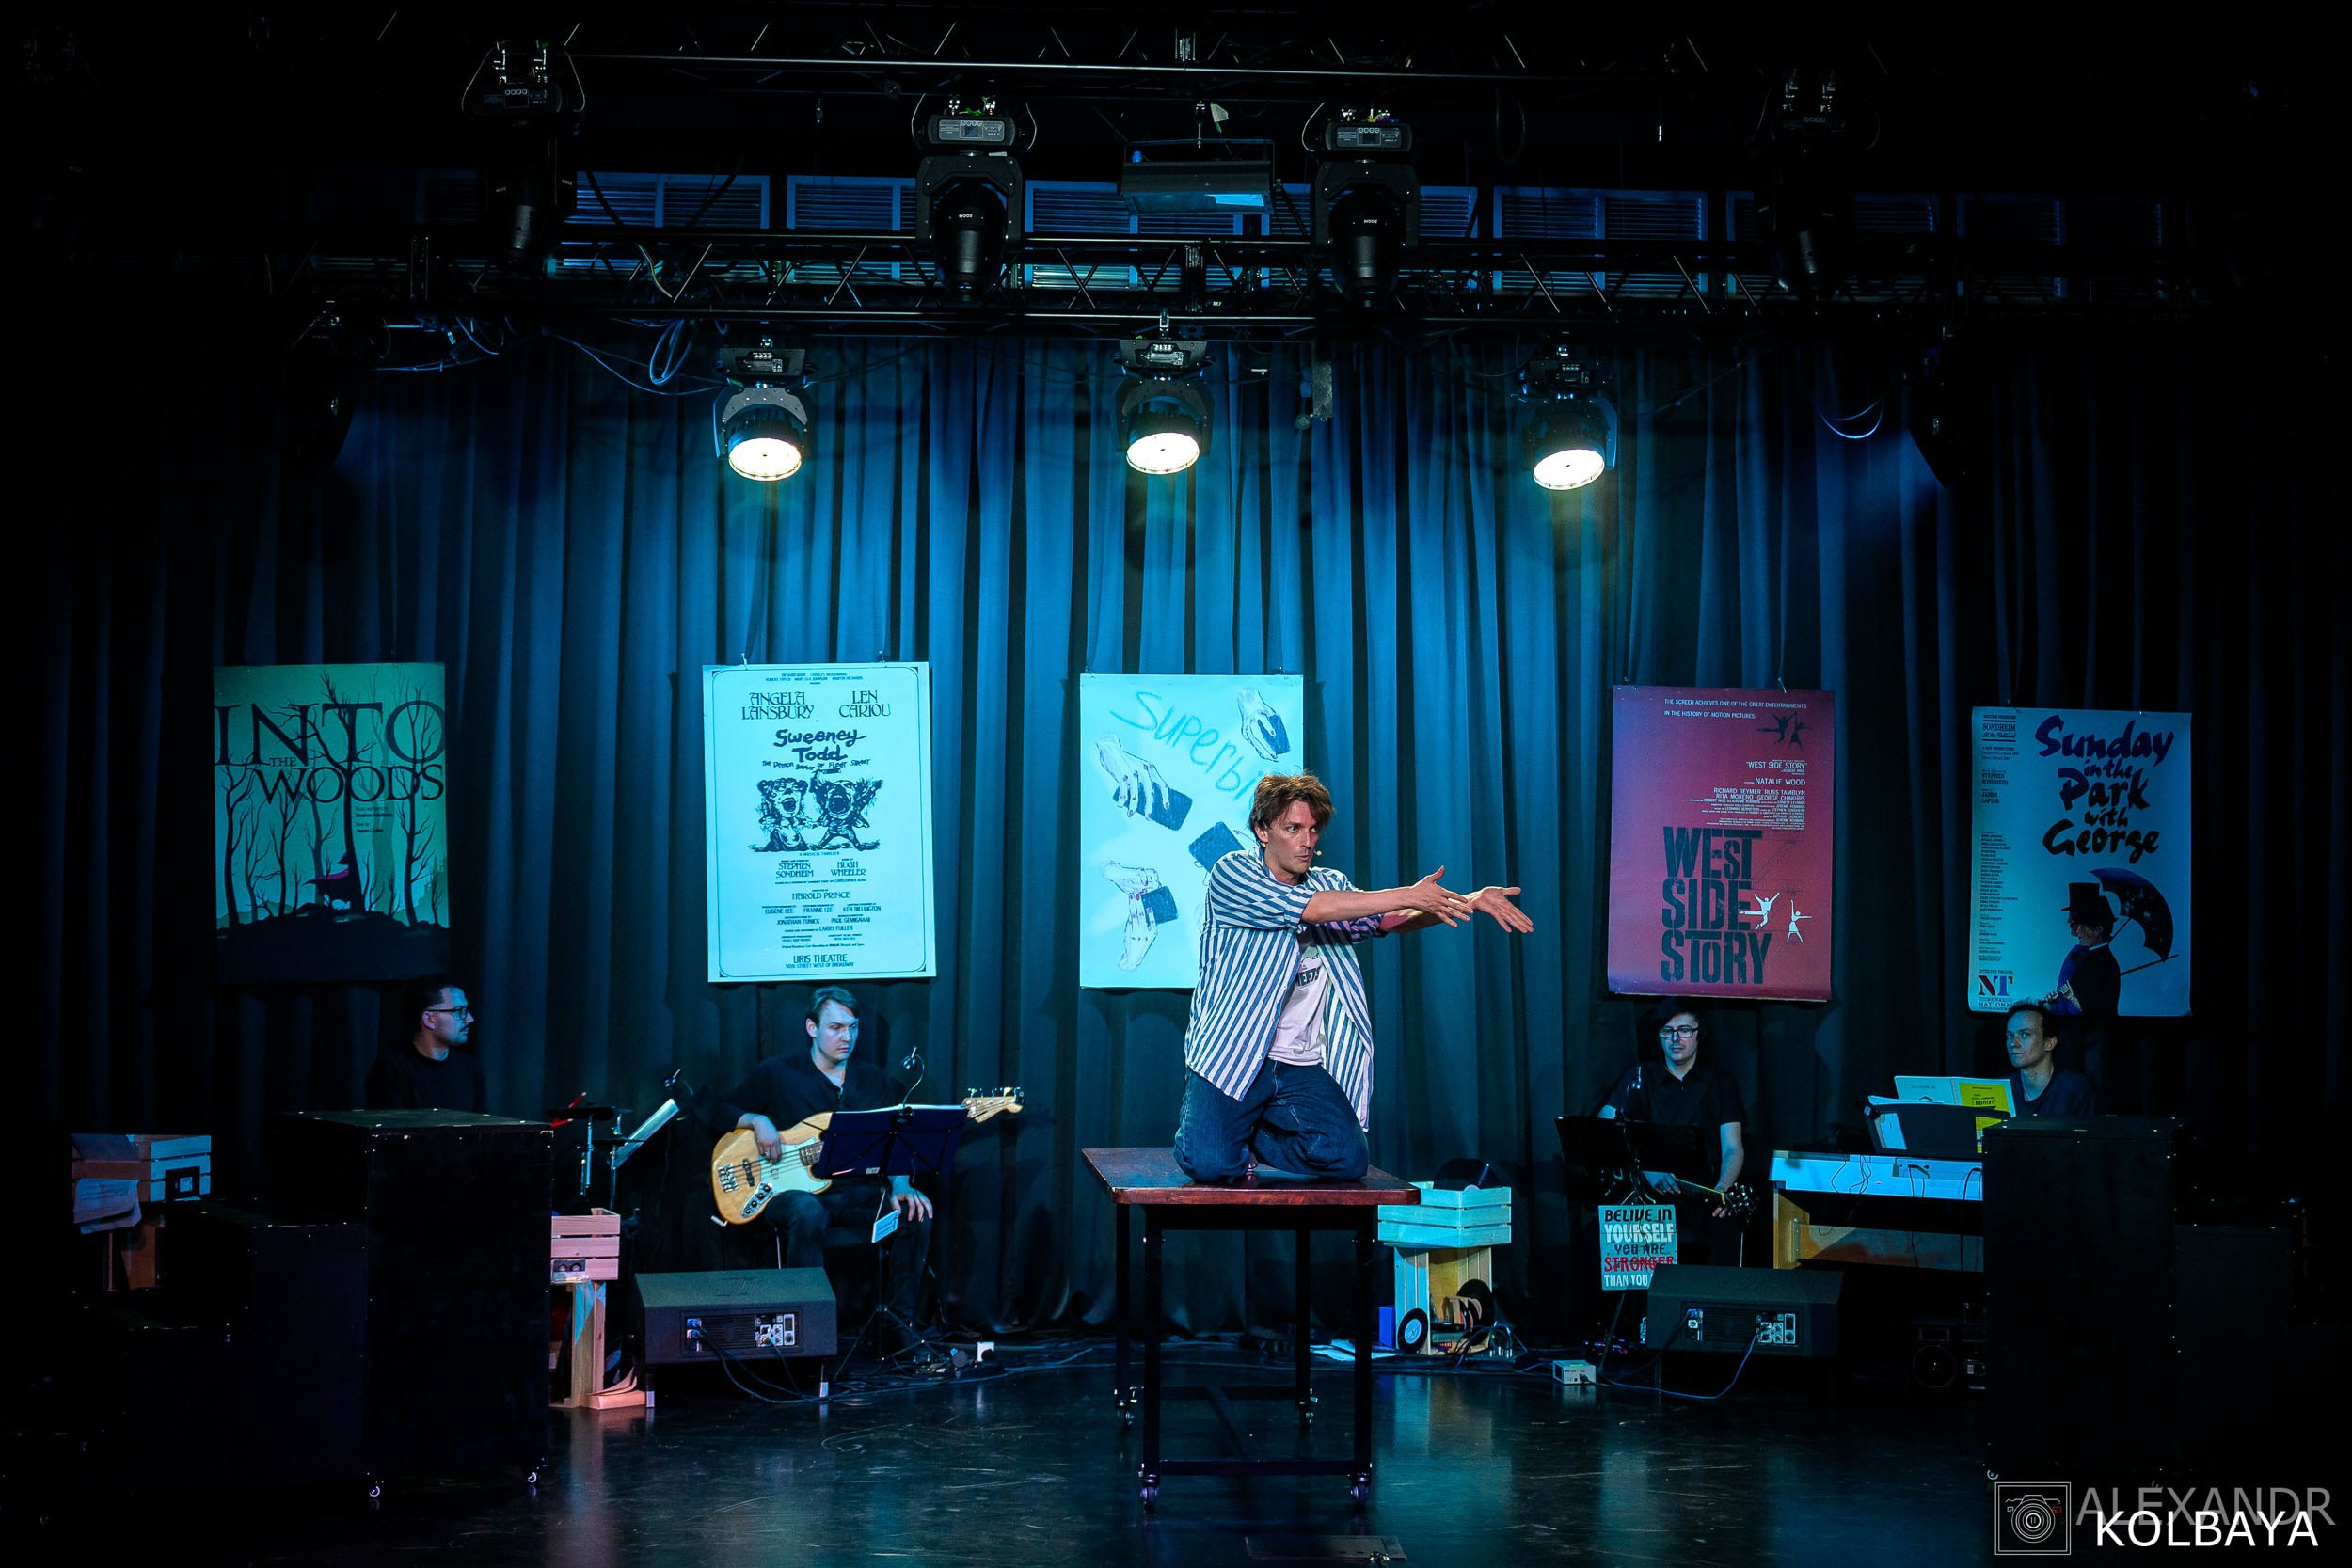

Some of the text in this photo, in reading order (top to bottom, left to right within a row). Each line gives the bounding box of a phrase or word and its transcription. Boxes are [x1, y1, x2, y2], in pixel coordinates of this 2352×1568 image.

[749, 691, 805, 705] ANGELA
[851, 690, 878, 704] LEN
[741, 705, 815, 720] LANSBURY
[839, 704, 891, 718] CARIOU
[214, 700, 445, 766] INTO
[773, 728, 867, 747] Sweeney
[2035, 714, 2174, 767] Sunday
[792, 745, 848, 763] Todd
[1109, 691, 1263, 810] Superbi
[269, 757, 297, 767] THE
[1769, 761, 1783, 769] SIDE
[2084, 758, 2133, 778] in the
[246, 765, 444, 804] WOODS
[2058, 767, 2150, 811] Park
[2085, 806, 2128, 827] with
[2042, 818, 2160, 864] George
[1663, 826, 1762, 879] WEST
[1661, 878, 1752, 930] SIDE
[794, 954, 848, 963] URIS THEATRE
[1661, 929, 1772, 984] STORY
[1978, 975, 2013, 996] NT
[1605, 1209, 1653, 1222] BELIVE
[1604, 1223, 1674, 1243] YOURSELF
[1614, 1243, 1666, 1255] YOU ARE
[1604, 1274, 1648, 1287] THAN YOU
